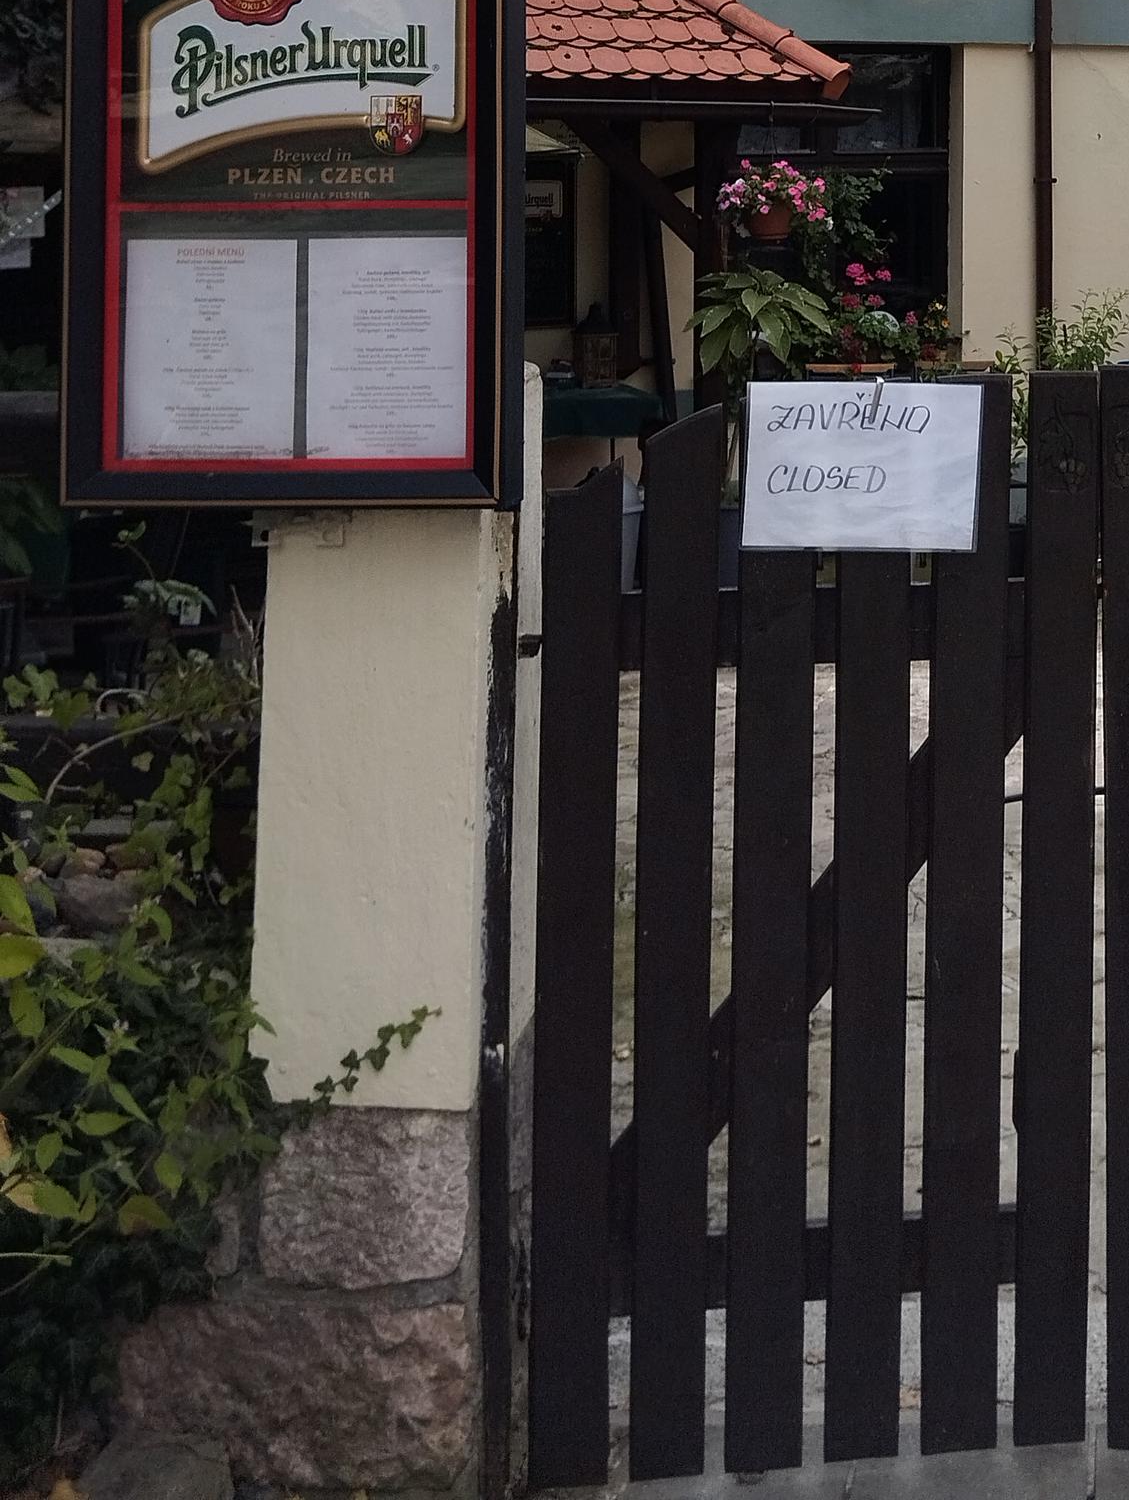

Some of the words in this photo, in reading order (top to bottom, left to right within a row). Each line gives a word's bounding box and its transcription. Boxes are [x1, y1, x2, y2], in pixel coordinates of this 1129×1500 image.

[171, 24, 307, 119] Pilsner
[301, 19, 430, 91] Urquell
[272, 148, 332, 163] Brewed
[336, 148, 352, 162] in
[320, 166, 395, 184] CZECH
[329, 191, 371, 200] PILSNER
[766, 392, 932, 434] ZAVŘENO
[766, 463, 888, 495] CLOSED
